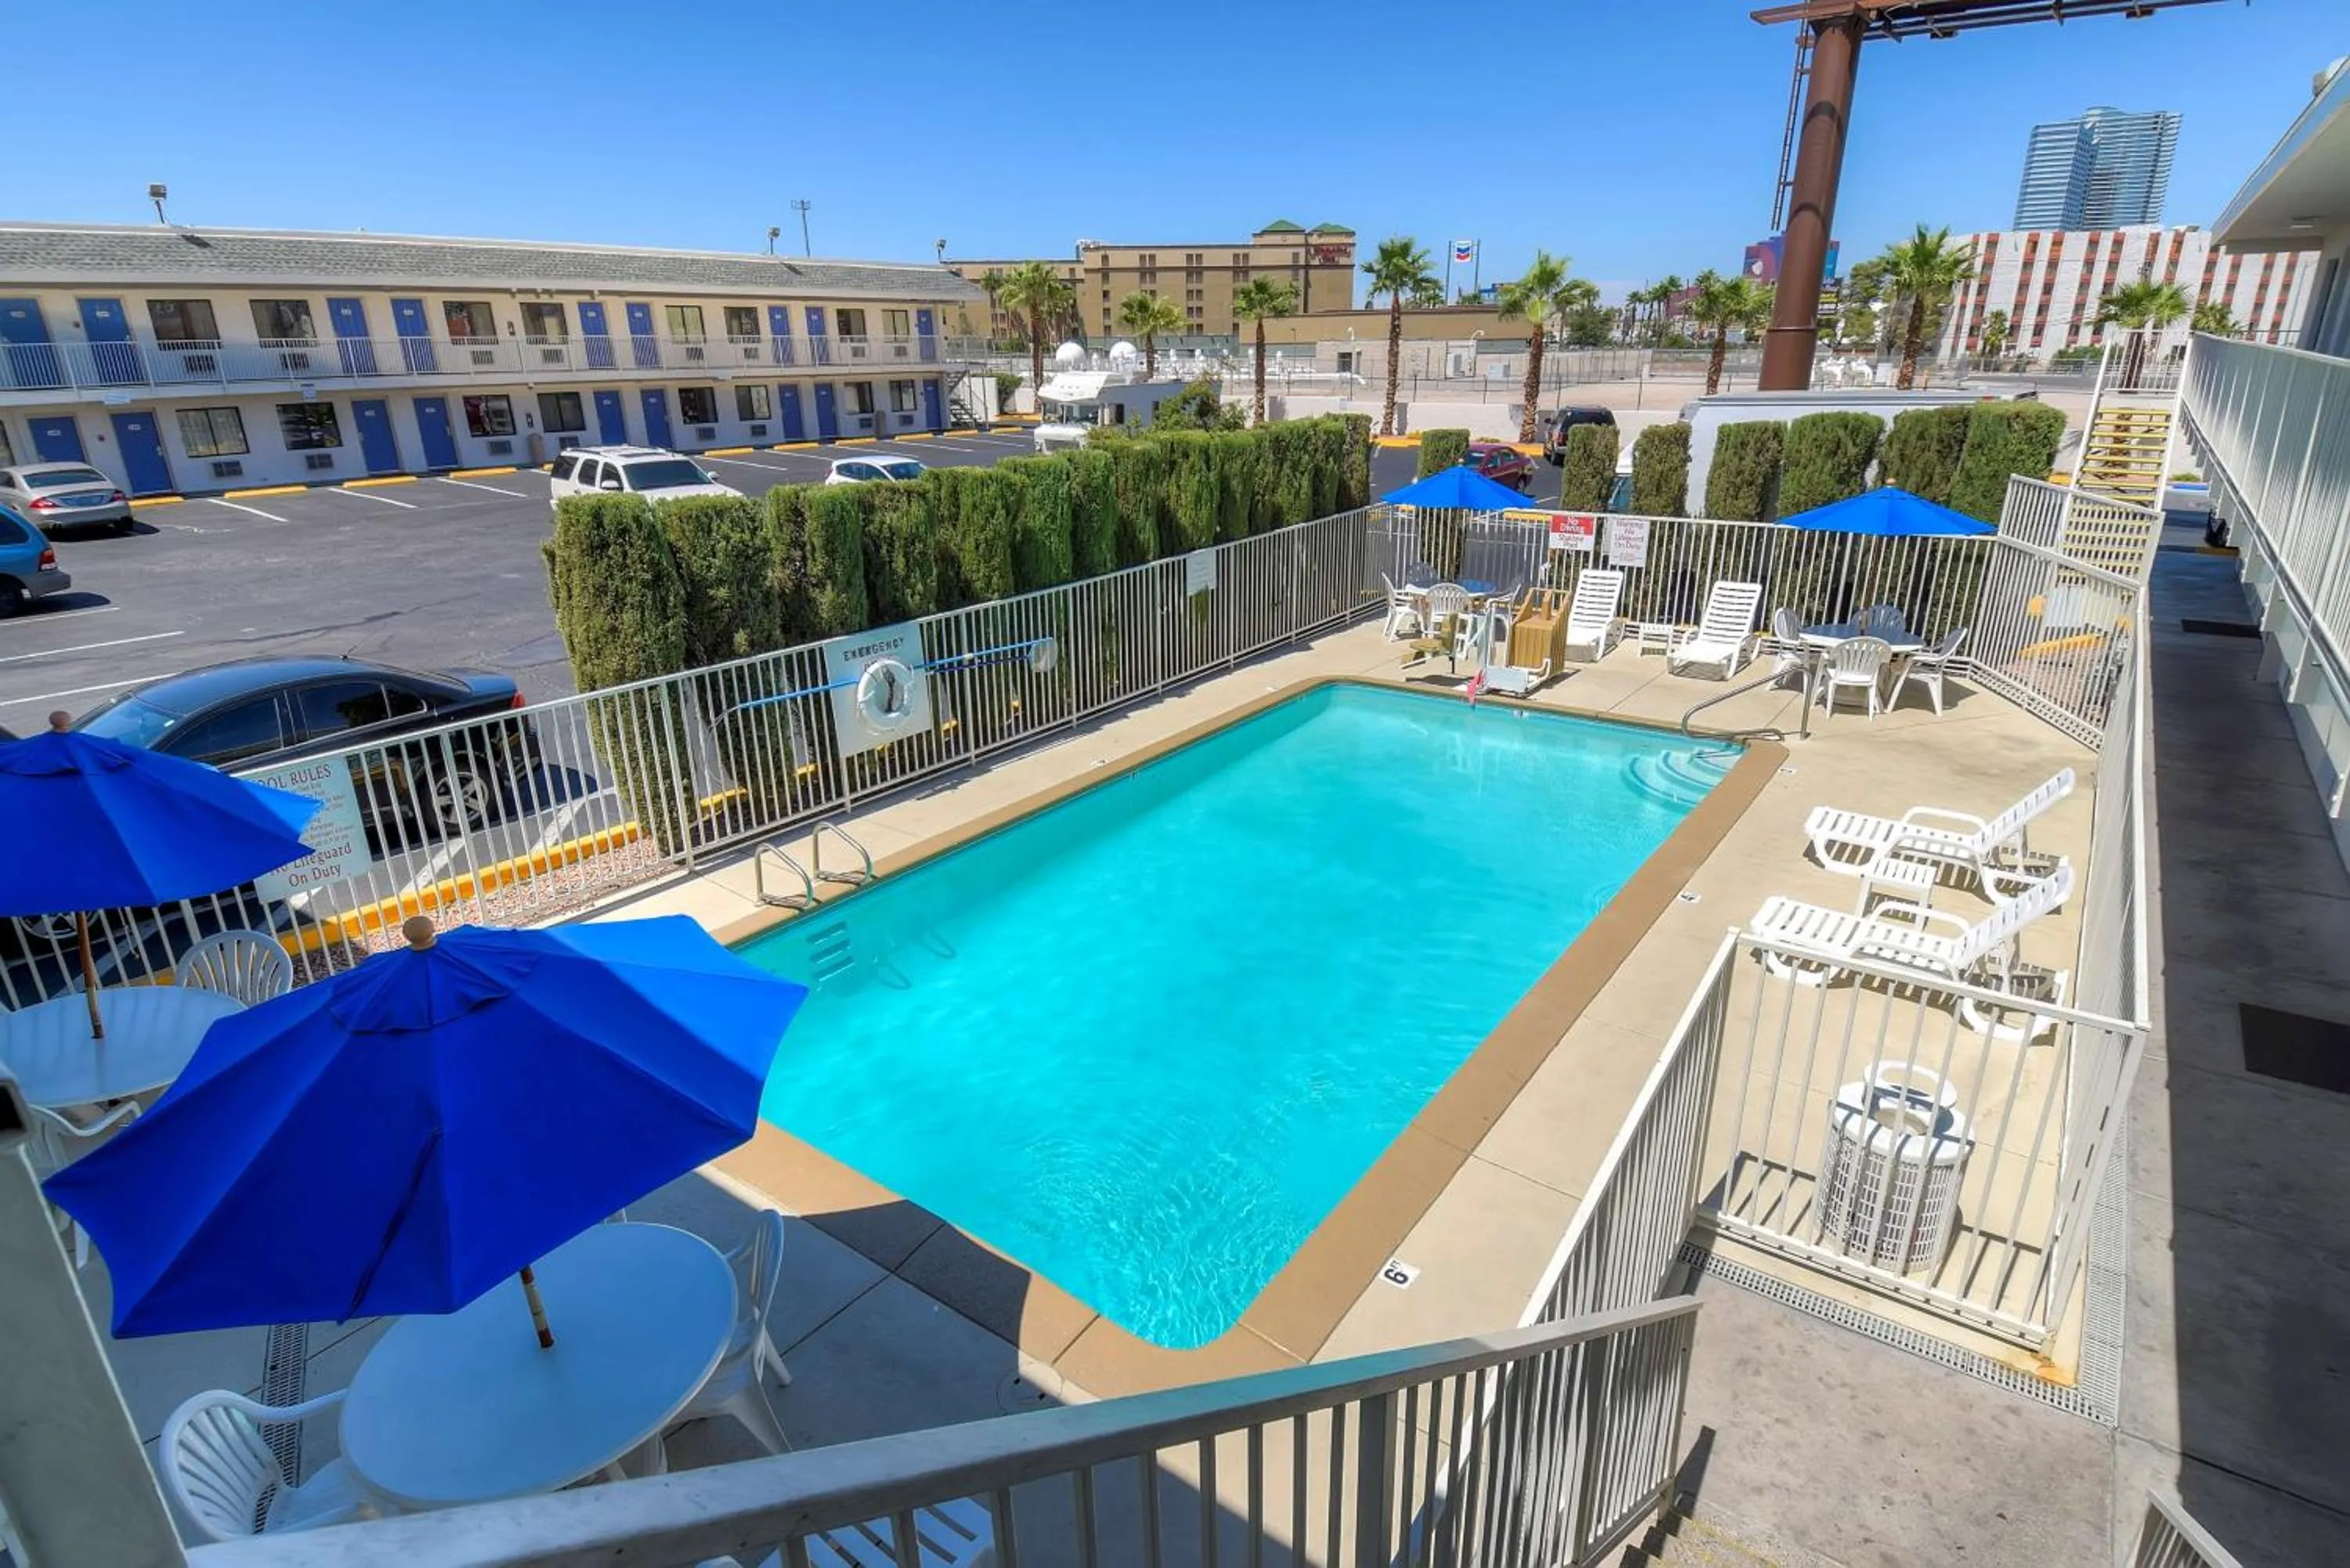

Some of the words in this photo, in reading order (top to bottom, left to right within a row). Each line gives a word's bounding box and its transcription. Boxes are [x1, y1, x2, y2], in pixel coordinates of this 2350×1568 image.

[1567, 515, 1579, 525] No
[843, 637, 905, 662] EMERGENCY
[289, 764, 331, 784] RULES
[288, 873, 308, 887] On
[313, 864, 342, 882] Duty
